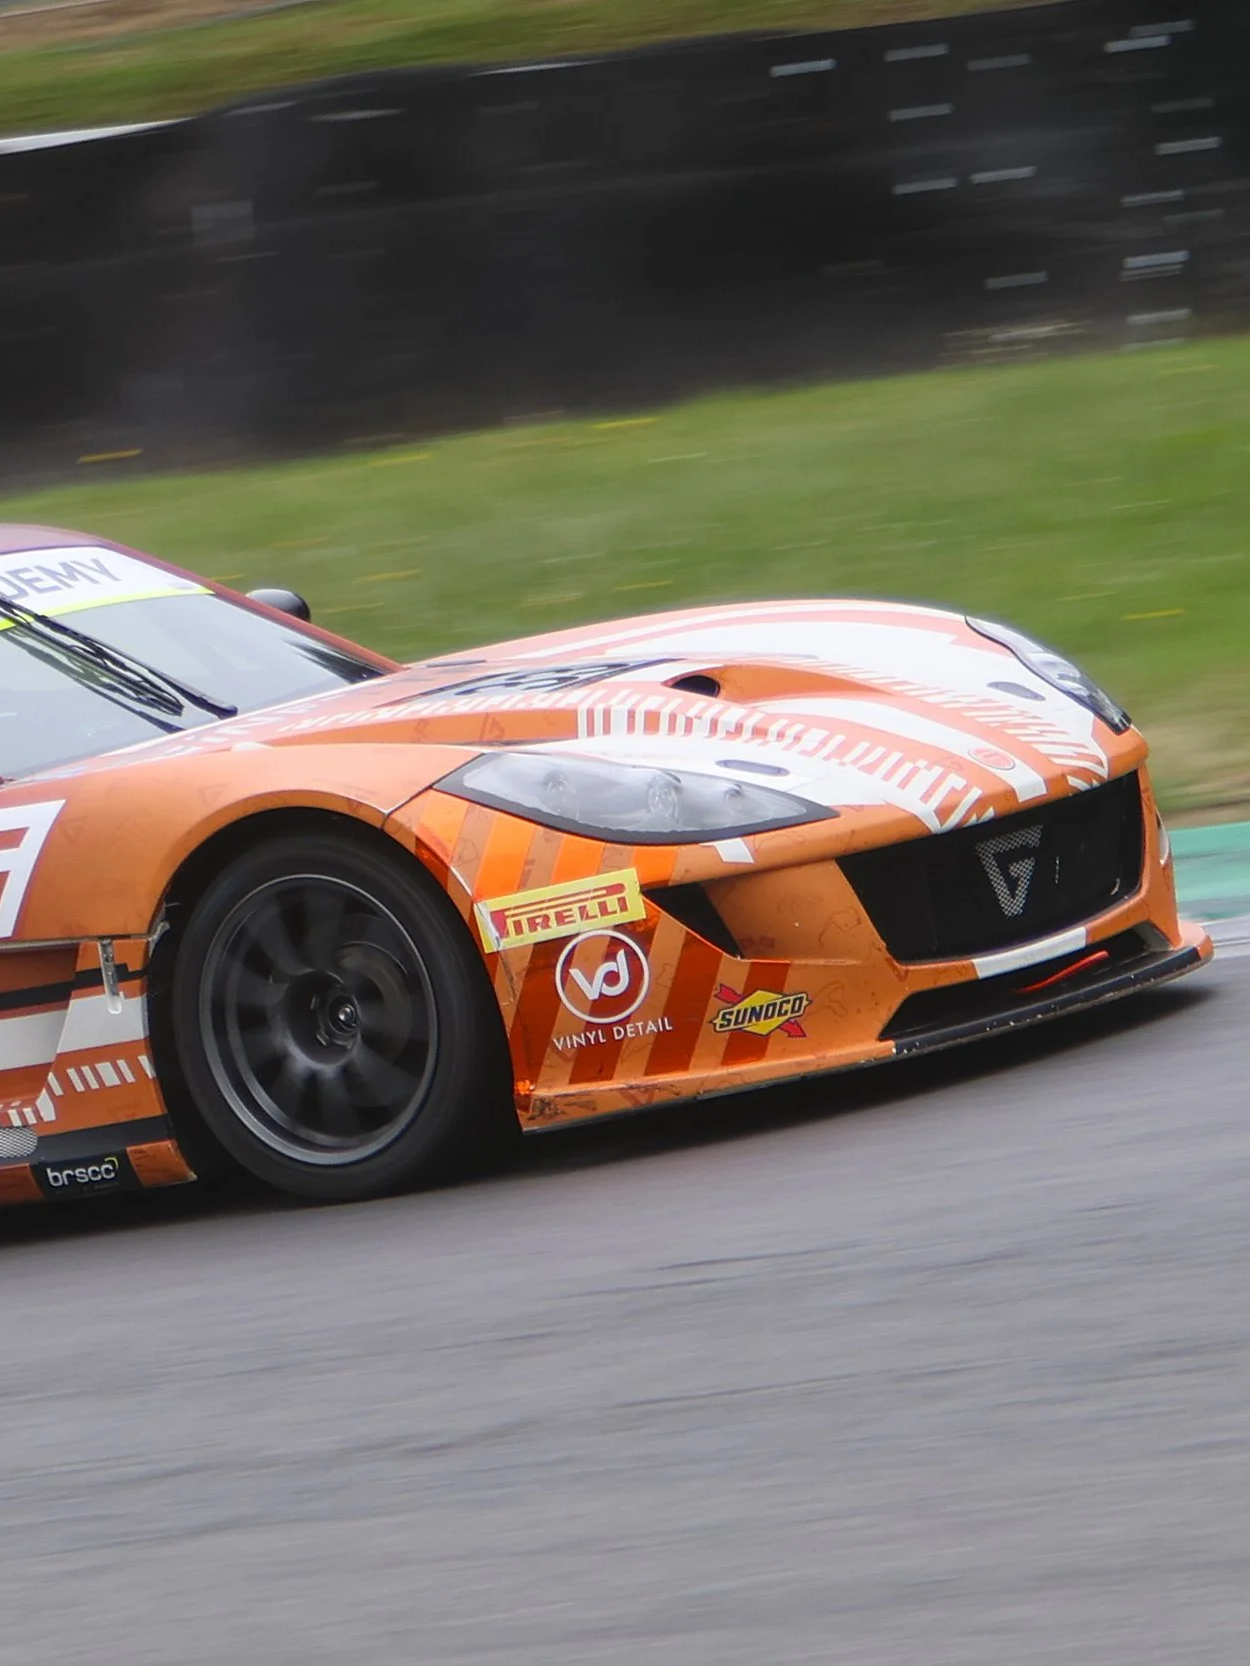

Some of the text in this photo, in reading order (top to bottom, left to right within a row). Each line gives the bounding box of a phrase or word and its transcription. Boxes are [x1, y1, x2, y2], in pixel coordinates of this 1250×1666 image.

[489, 882, 630, 940] PIRELLI
[718, 992, 807, 1030] SUNOCO
[552, 1016, 674, 1052] VINYL DETAIL
[46, 1163, 117, 1187] brscc
